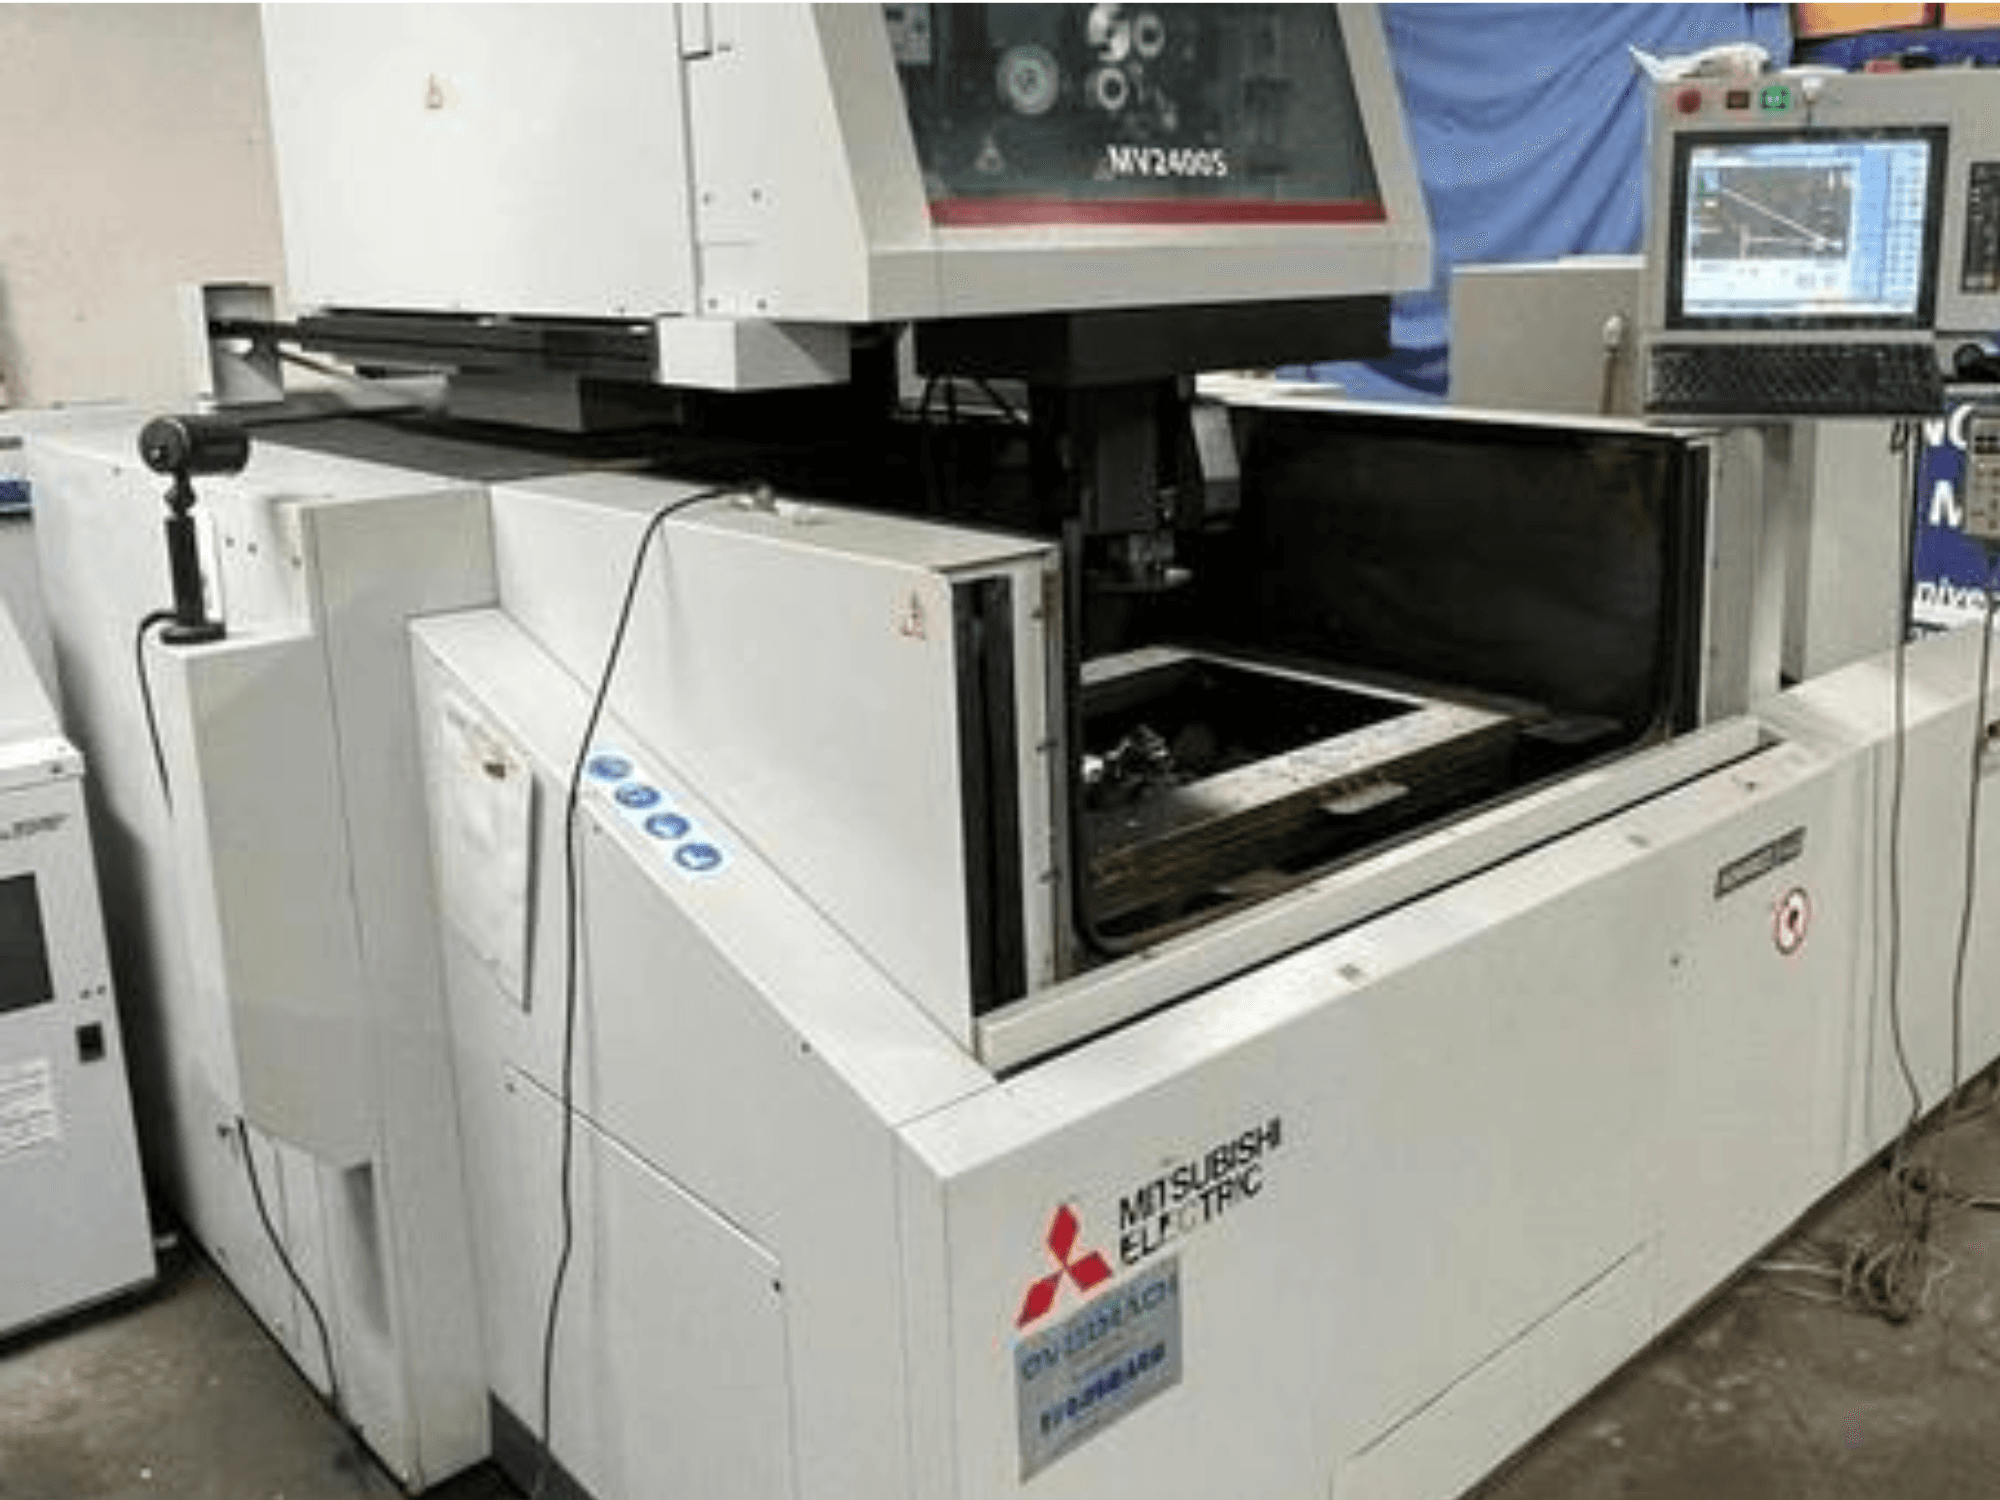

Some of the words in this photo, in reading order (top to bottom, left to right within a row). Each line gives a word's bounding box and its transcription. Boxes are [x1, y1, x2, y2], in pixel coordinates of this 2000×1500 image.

[1106, 144, 1228, 177] MV2400S
[1119, 1115, 1282, 1231] MITSUBISHI
[1119, 1162, 1264, 1266] ELECTRIC
